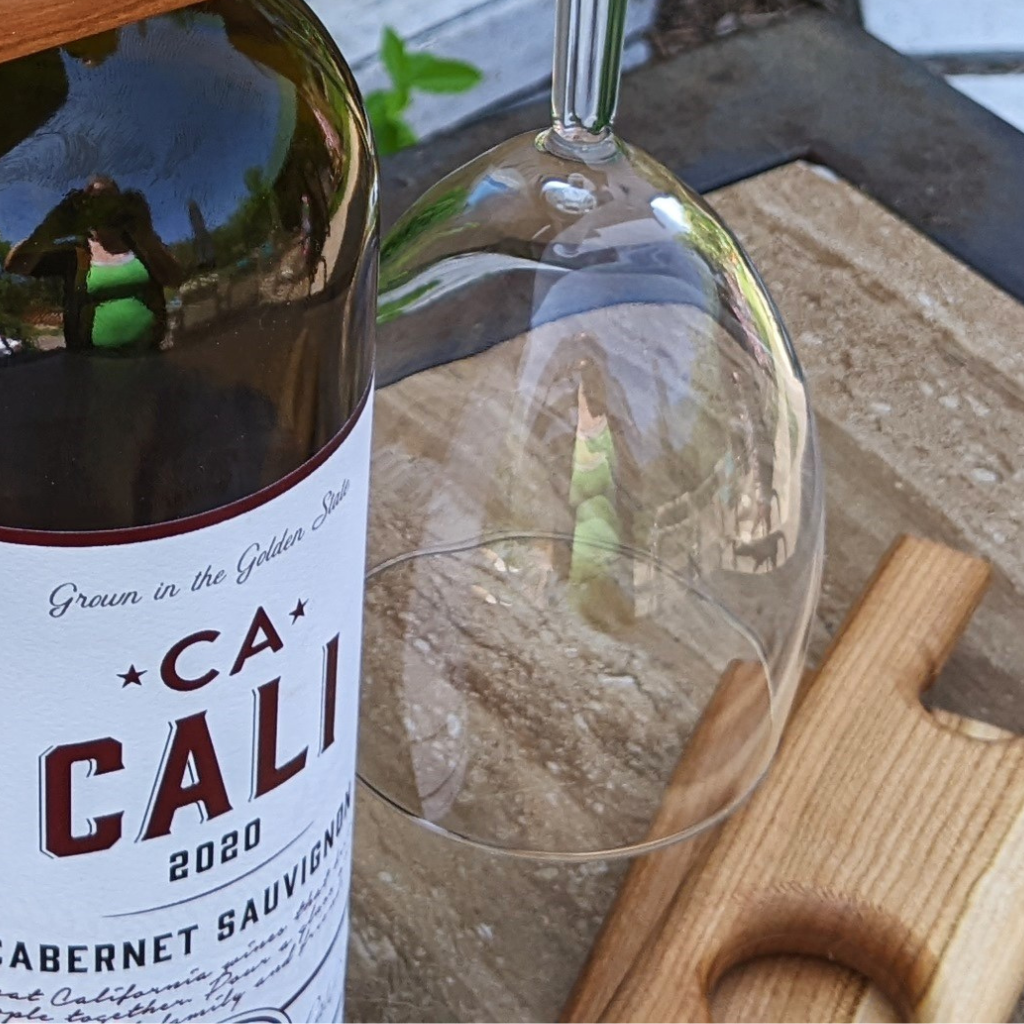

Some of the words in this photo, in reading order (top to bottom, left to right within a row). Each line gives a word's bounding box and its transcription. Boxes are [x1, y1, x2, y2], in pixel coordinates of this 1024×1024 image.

[49, 582, 143, 618] Grown
[153, 581, 181, 601] in
[191, 564, 227, 591] the
[236, 528, 306, 584] Golden
[160, 605, 284, 691] CA
[38, 632, 340, 859] CALI
[169, 818, 262, 882] 2020
[217, 779, 352, 942] SAUVIGNON
[50, 967, 214, 1006] California
